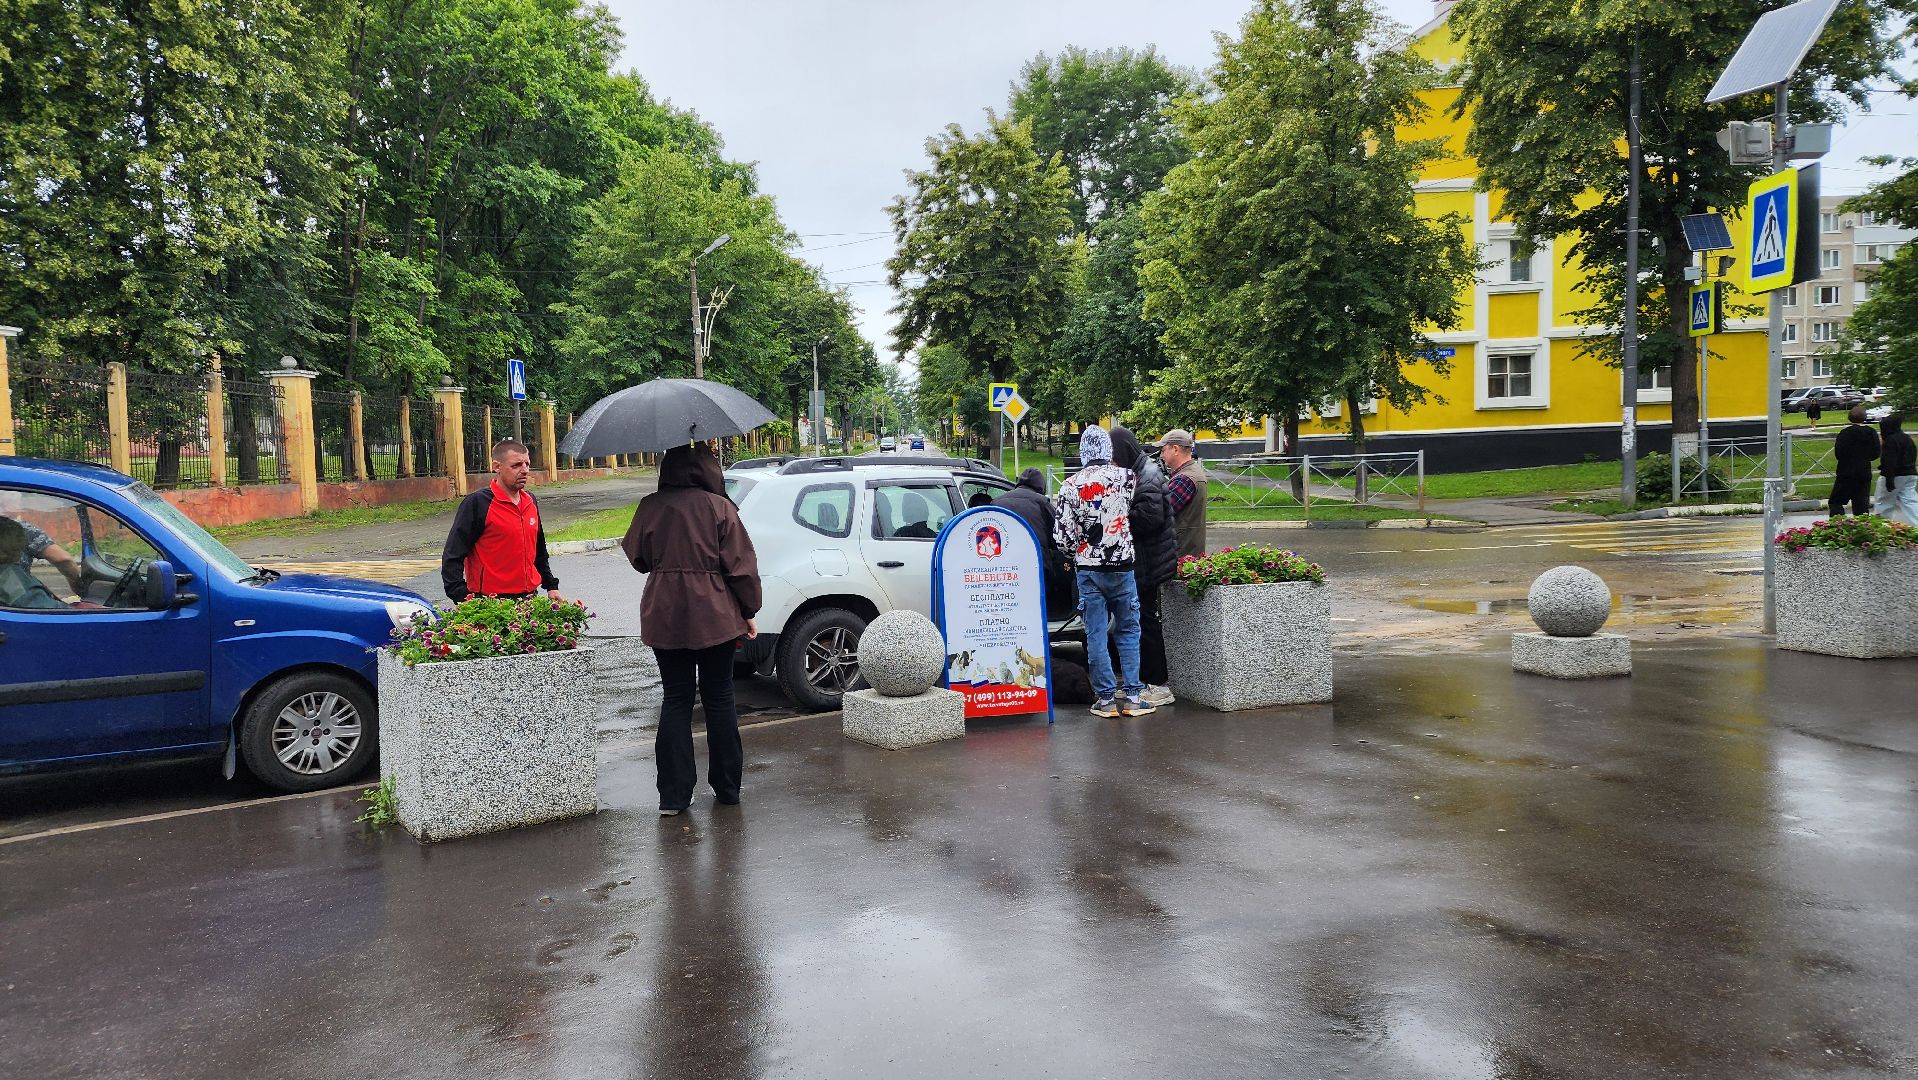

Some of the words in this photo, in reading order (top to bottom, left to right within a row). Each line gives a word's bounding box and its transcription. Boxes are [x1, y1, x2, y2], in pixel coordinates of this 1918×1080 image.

[964, 573, 1018, 582] БЕШЕНСТВА
[970, 592, 1015, 602] БЕСПЛАТНО
[979, 618, 1010, 627] ПЛАТНО
[973, 692, 995, 703] (499)
[997, 690, 1037, 700] 113-94-09
